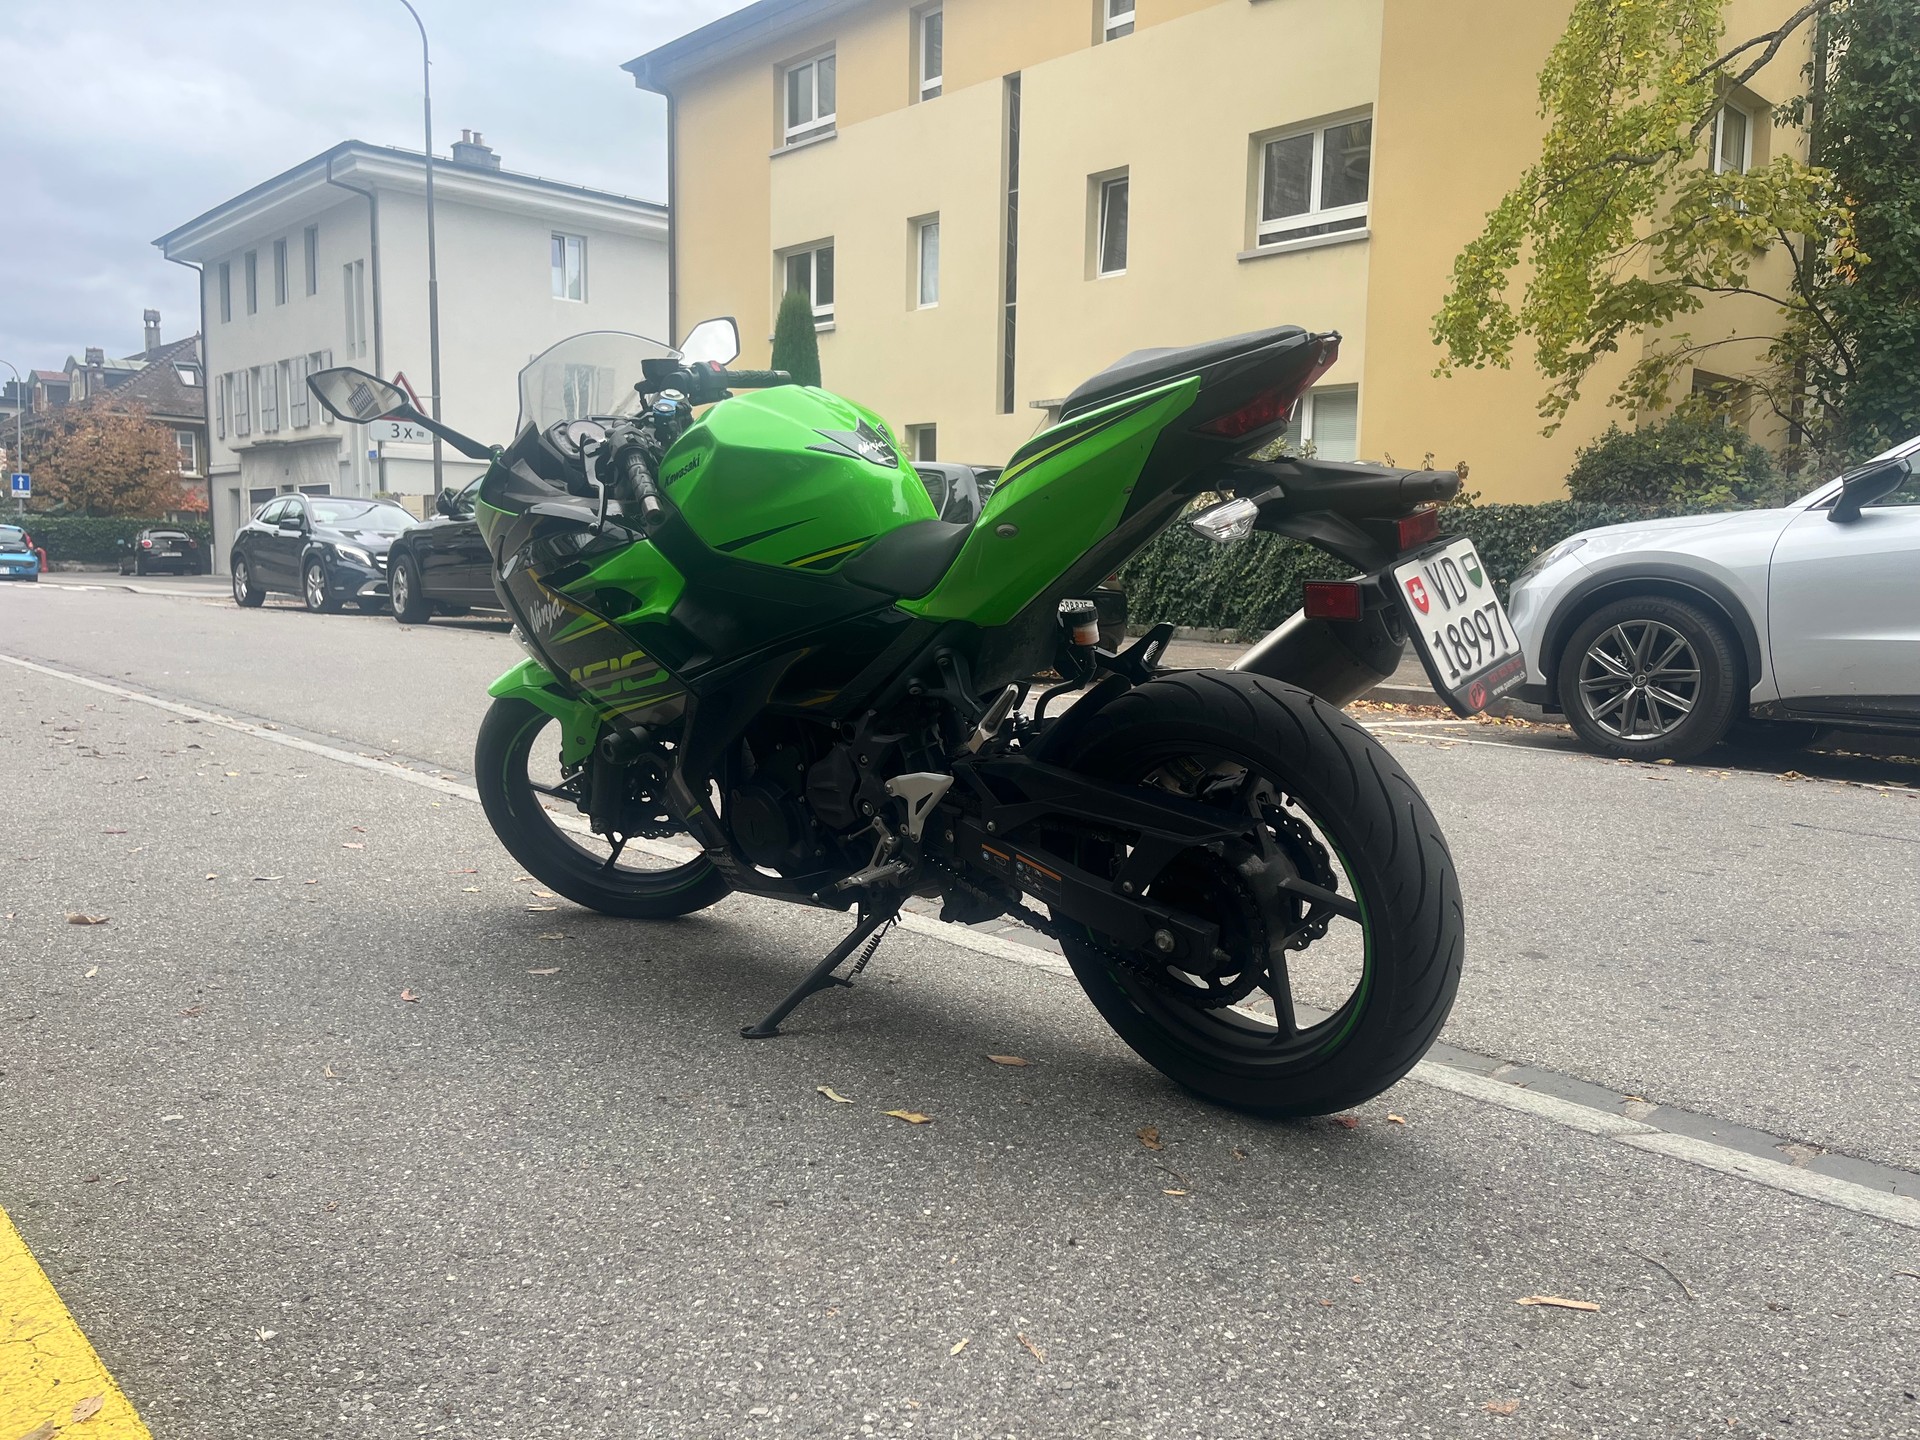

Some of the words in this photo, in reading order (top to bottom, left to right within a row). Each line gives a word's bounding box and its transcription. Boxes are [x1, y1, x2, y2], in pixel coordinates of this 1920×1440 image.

[391, 423, 400, 438] 3
[858, 440, 887, 454] Ninja
[664, 454, 701, 489] Kawasaki
[1424, 557, 1468, 611] VD
[530, 592, 565, 634] Ninja
[1433, 600, 1509, 679] 18997
